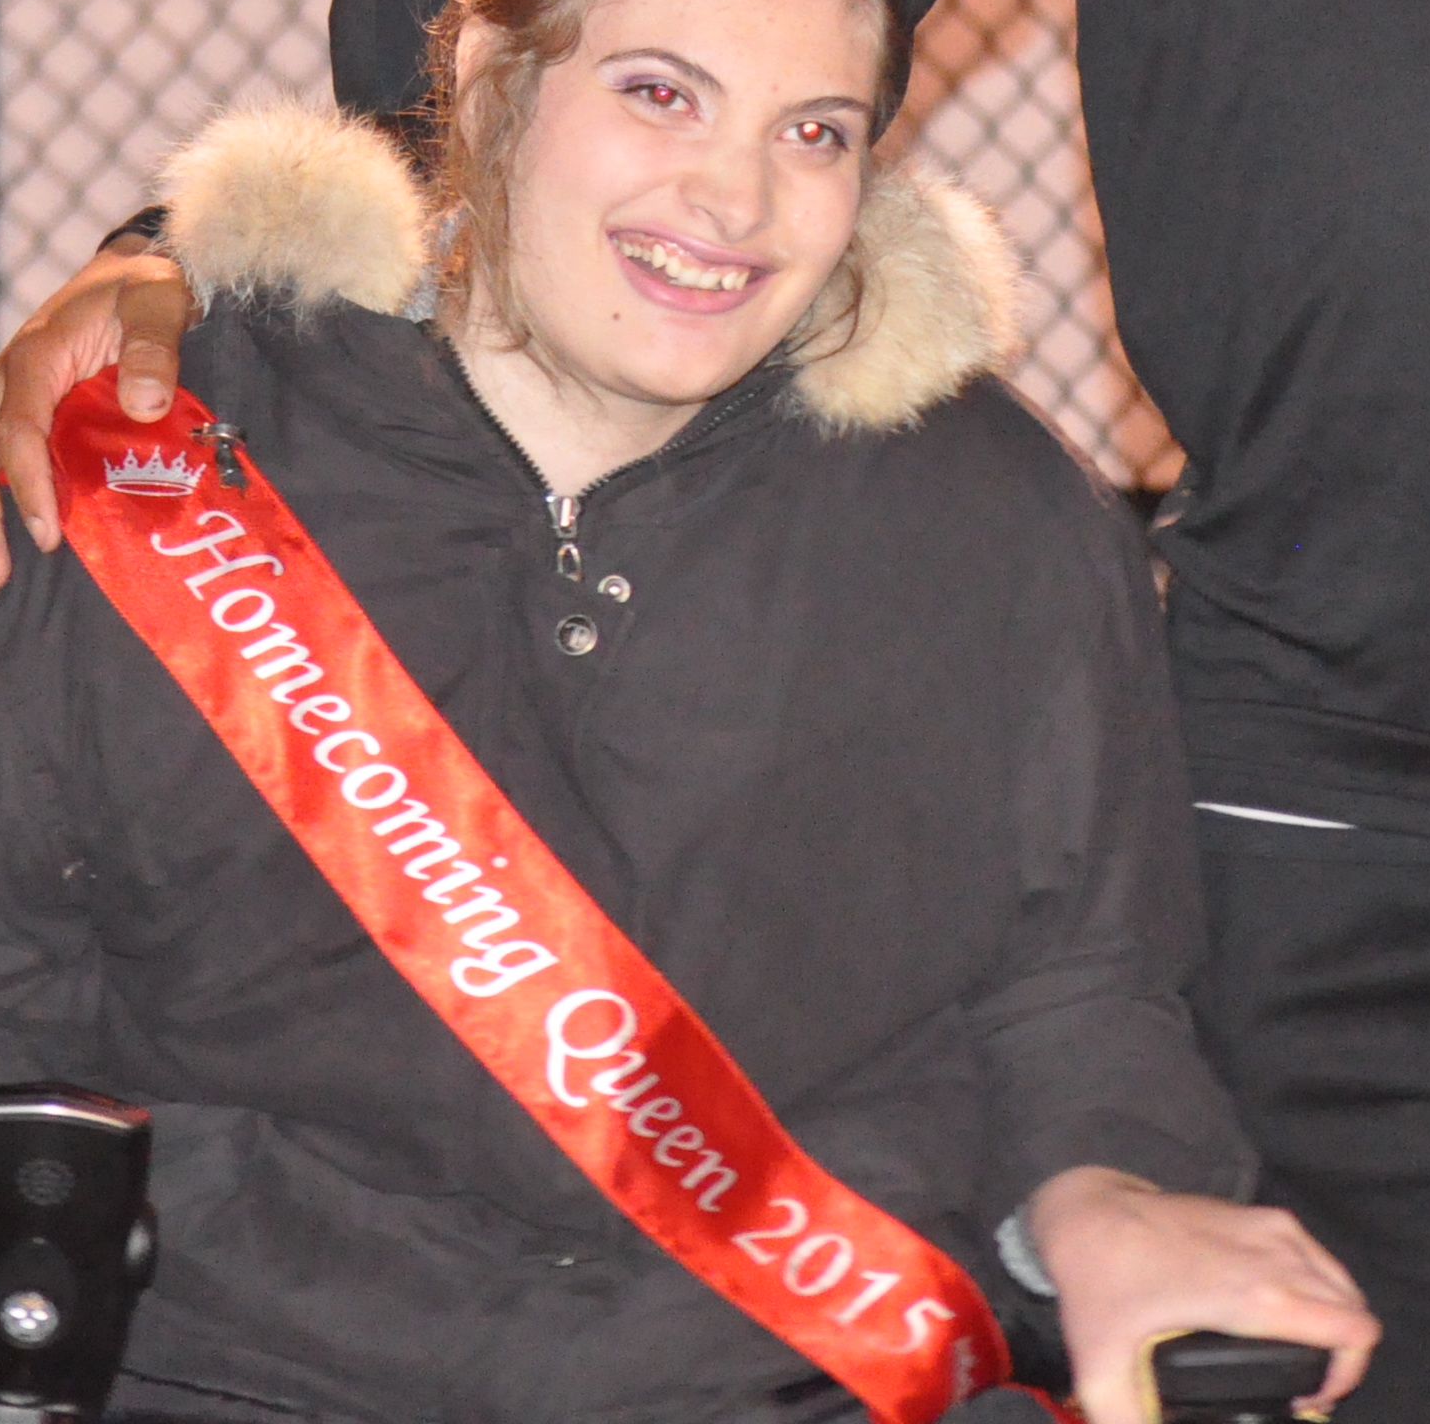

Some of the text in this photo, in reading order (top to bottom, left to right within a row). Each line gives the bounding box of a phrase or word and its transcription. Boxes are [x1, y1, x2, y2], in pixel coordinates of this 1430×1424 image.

[150, 509, 956, 1355] Homecoming Queen 2015
